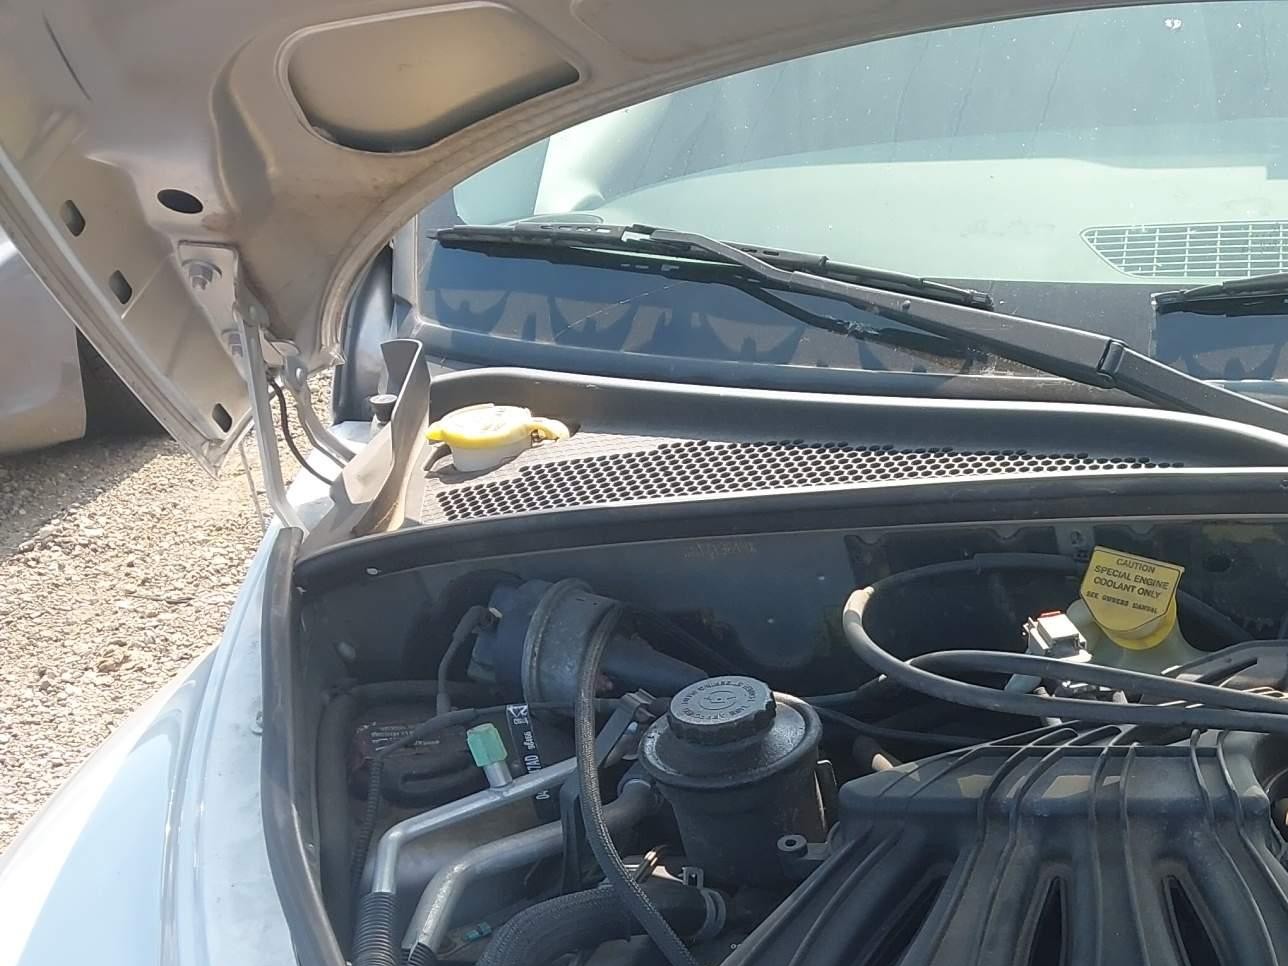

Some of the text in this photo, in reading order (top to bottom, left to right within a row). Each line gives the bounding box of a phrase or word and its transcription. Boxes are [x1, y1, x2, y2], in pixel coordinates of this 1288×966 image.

[1094, 565, 1170, 590] SPECIAL ENGINE
[1116, 558, 1156, 574] CAUTION
[1093, 576, 1161, 600] COOLANT ONLY
